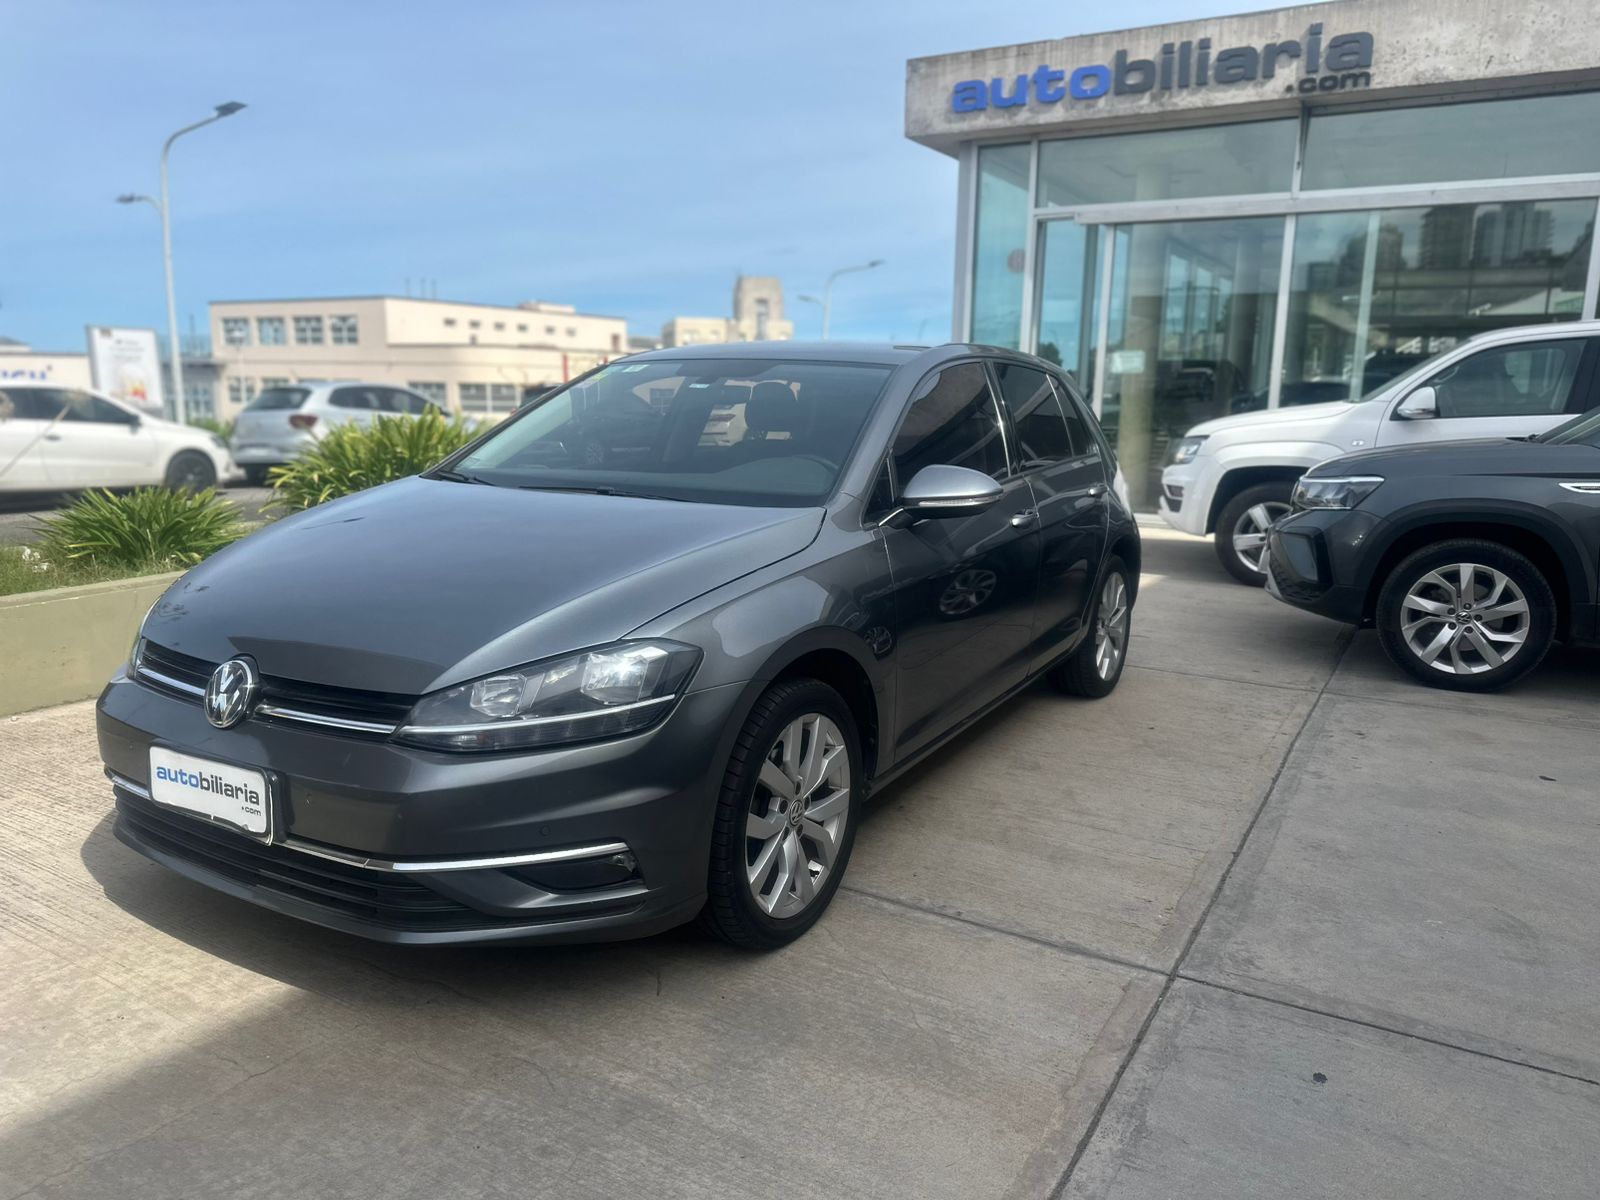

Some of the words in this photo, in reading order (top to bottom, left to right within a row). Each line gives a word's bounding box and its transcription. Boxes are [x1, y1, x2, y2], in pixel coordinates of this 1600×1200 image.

[952, 23, 1373, 113] autobiliaria
[1285, 71, 1371, 93] .com
[156, 766, 260, 806] autobiliaria
[241, 805, 262, 817] .com
